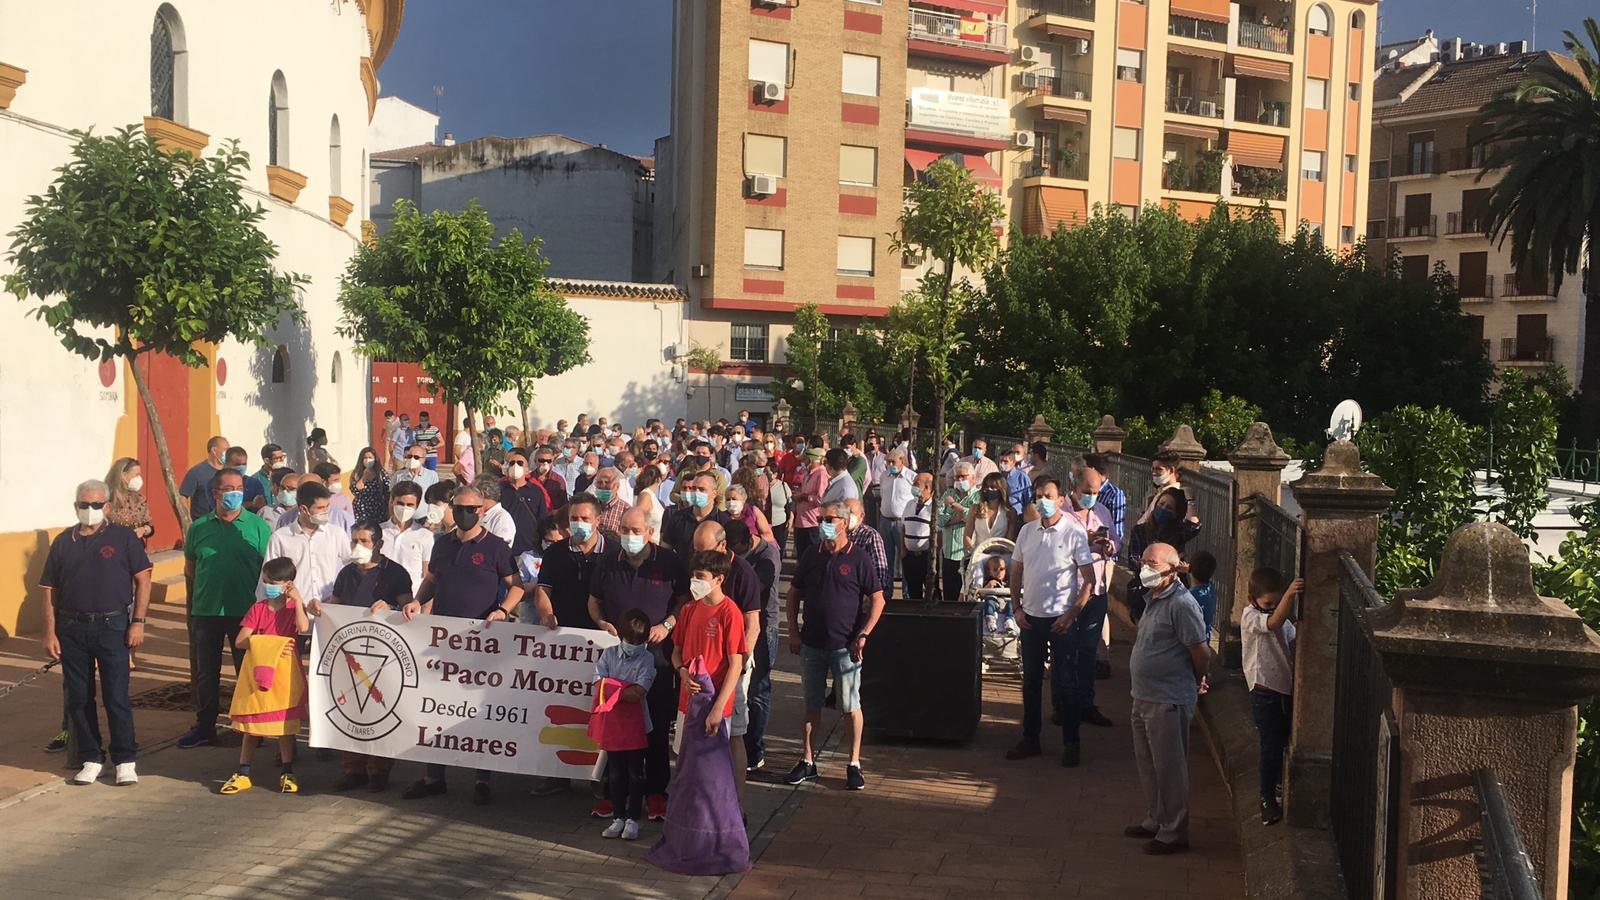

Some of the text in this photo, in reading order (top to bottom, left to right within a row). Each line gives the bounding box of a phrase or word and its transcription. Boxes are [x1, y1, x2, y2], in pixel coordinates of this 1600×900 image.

[335, 625, 367, 646] TAURINA
[369, 625, 392, 640] PACO
[391, 637, 413, 677] MORENO
[428, 626, 501, 655] Peña
[420, 697, 529, 725] Desde 1961
[346, 722, 375, 736] LINARES
[415, 726, 518, 757] Linares
